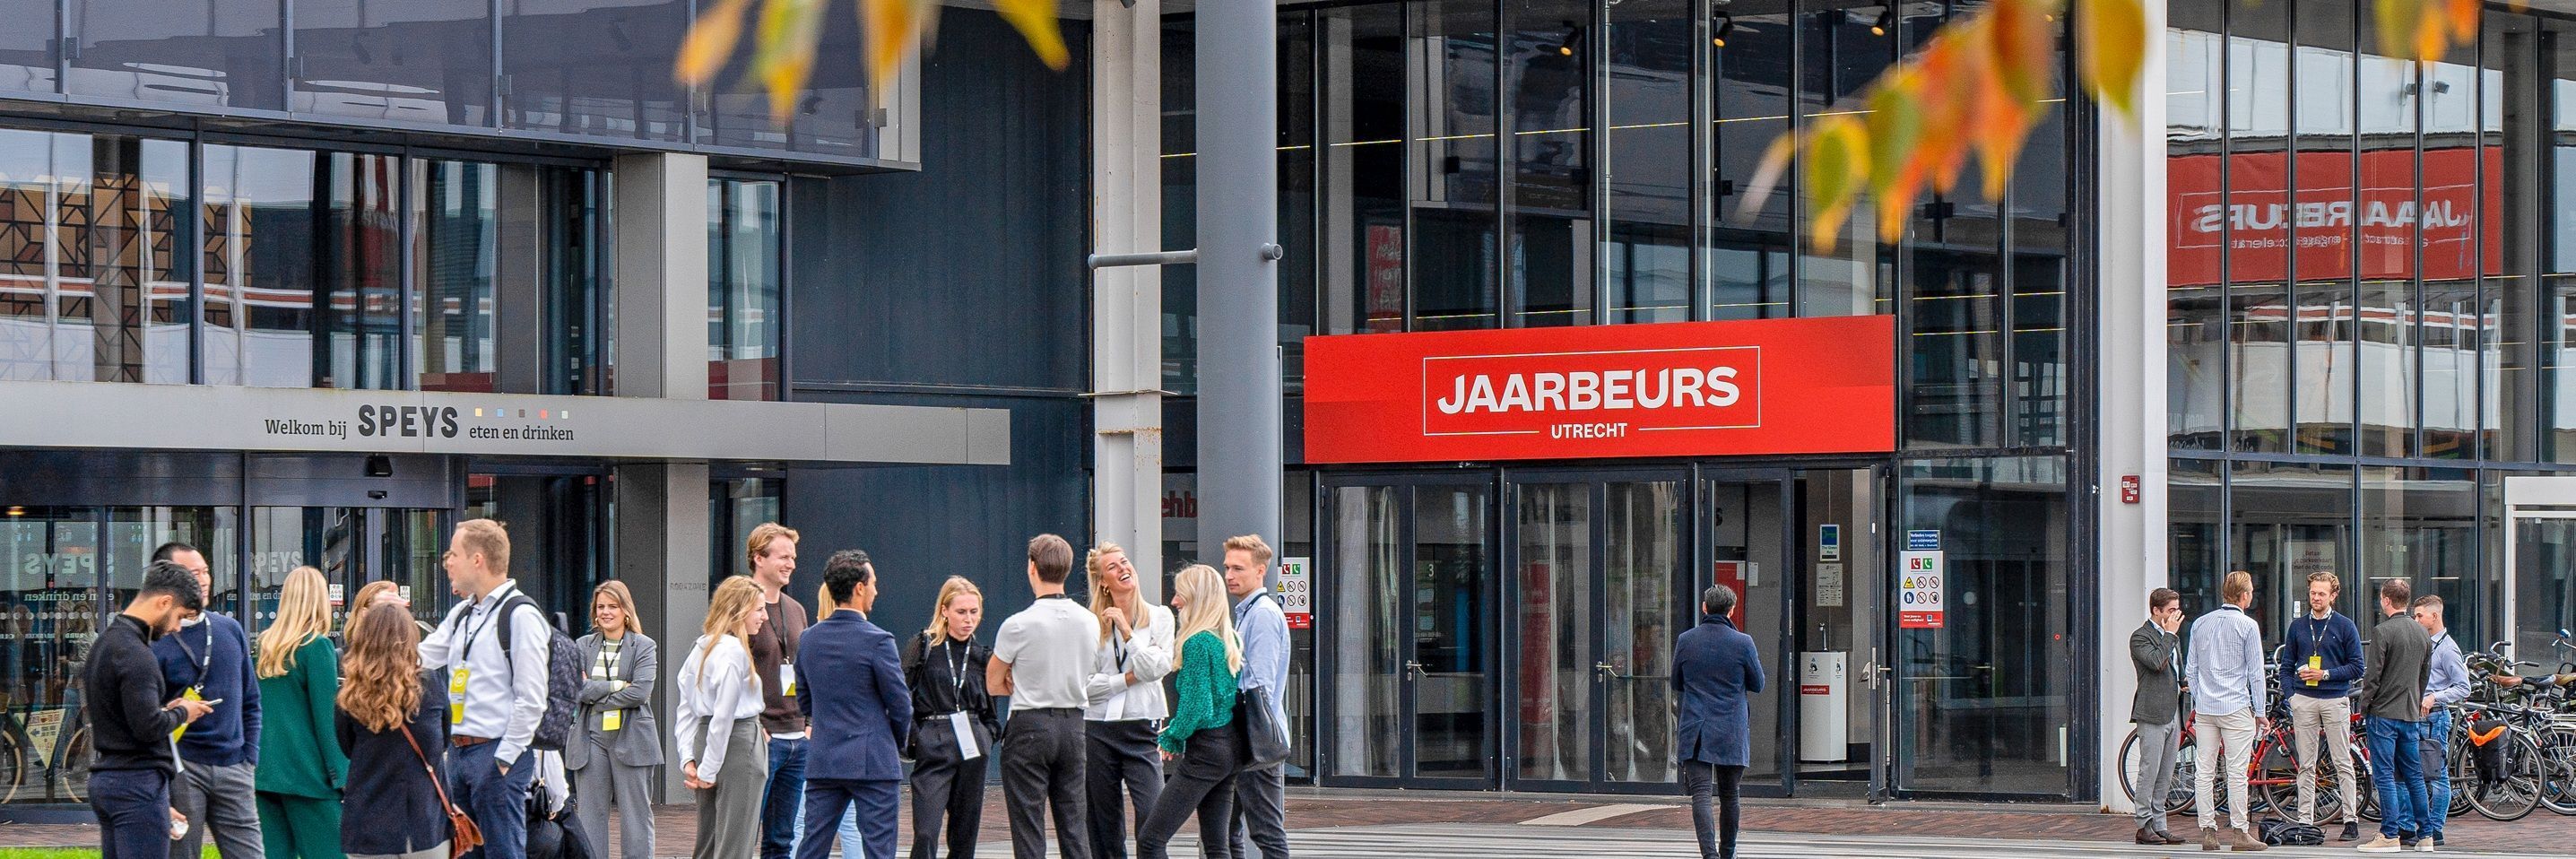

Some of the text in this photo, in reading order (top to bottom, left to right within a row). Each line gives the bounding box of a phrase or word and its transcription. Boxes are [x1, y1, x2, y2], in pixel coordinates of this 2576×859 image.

[1437, 366, 1740, 414] JAARBEURS
[265, 403, 574, 440] Welkom bij SPEYS eten en drinken
[1551, 422, 1628, 439] UTRECHT
